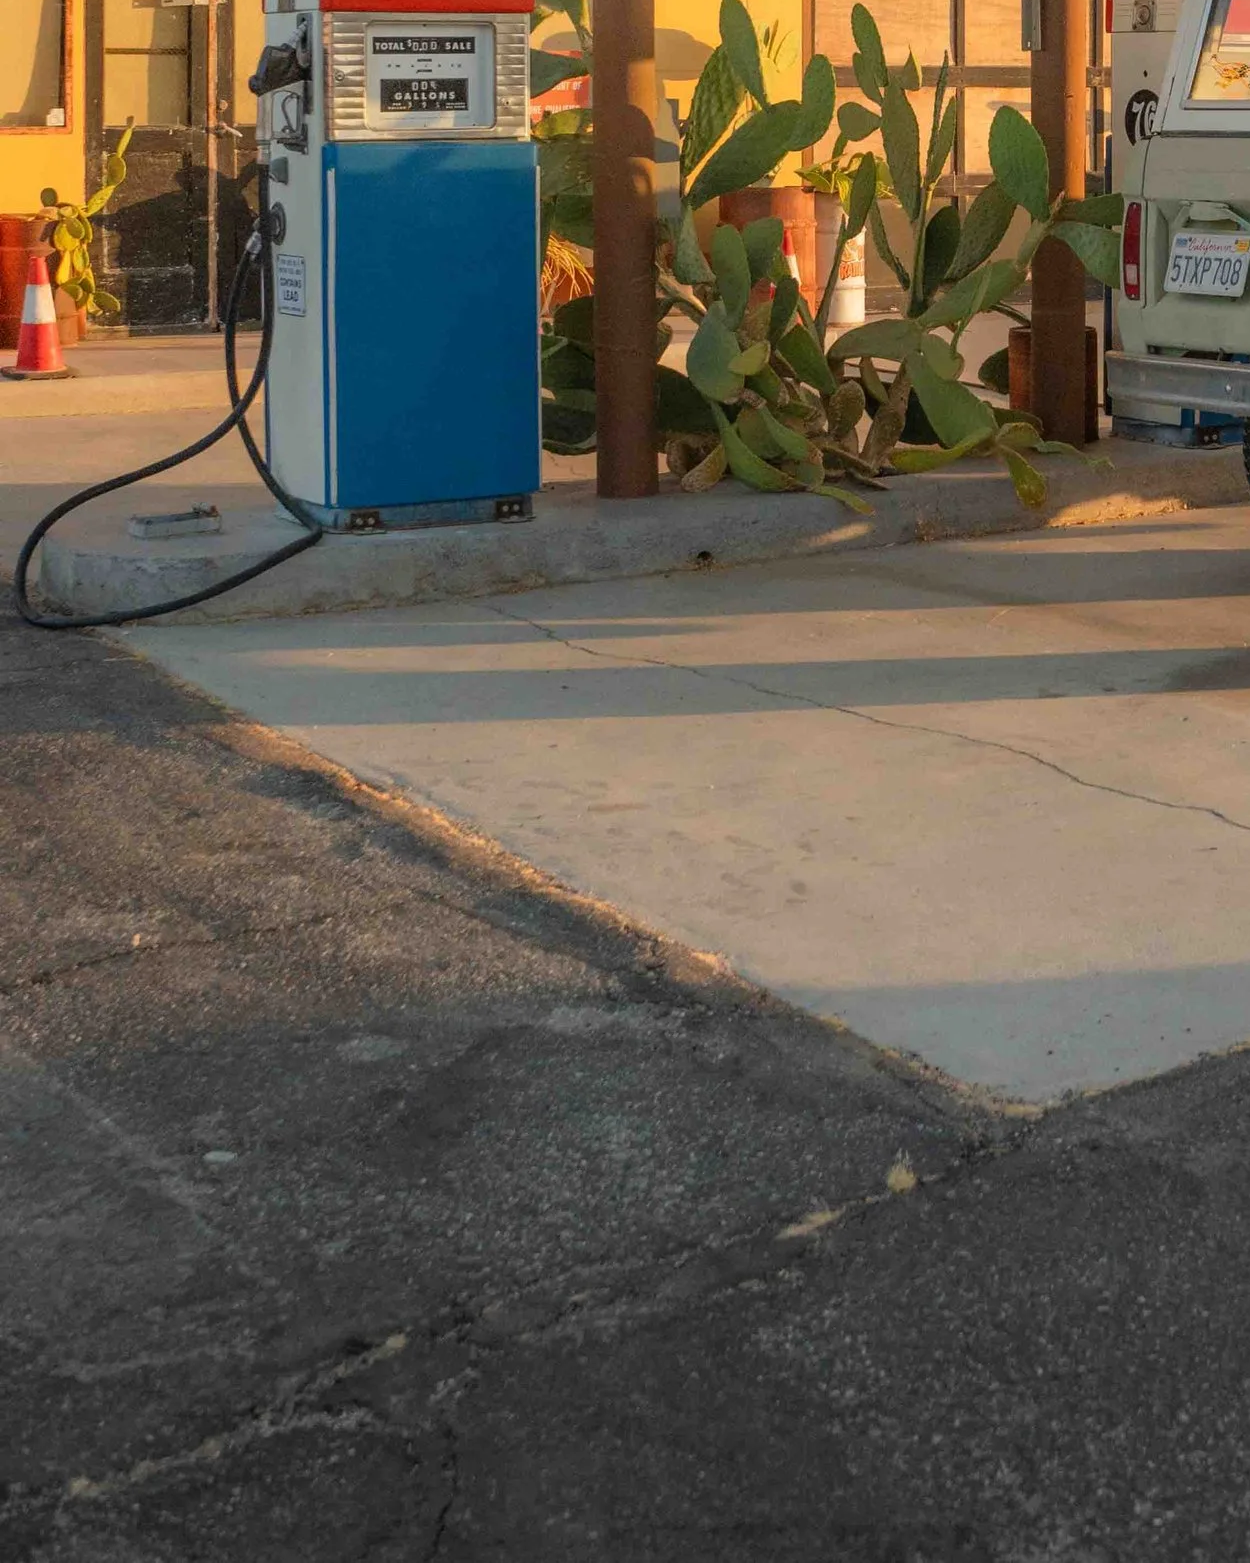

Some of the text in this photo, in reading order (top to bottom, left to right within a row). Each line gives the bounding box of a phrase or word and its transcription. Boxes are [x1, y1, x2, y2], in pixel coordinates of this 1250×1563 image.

[375, 42, 405, 51] TOTAL
[445, 41, 472, 50] SALE
[394, 91, 456, 100] GALLONS
[1132, 100, 1157, 140] 76
[1171, 255, 1243, 286] 5TXP708
